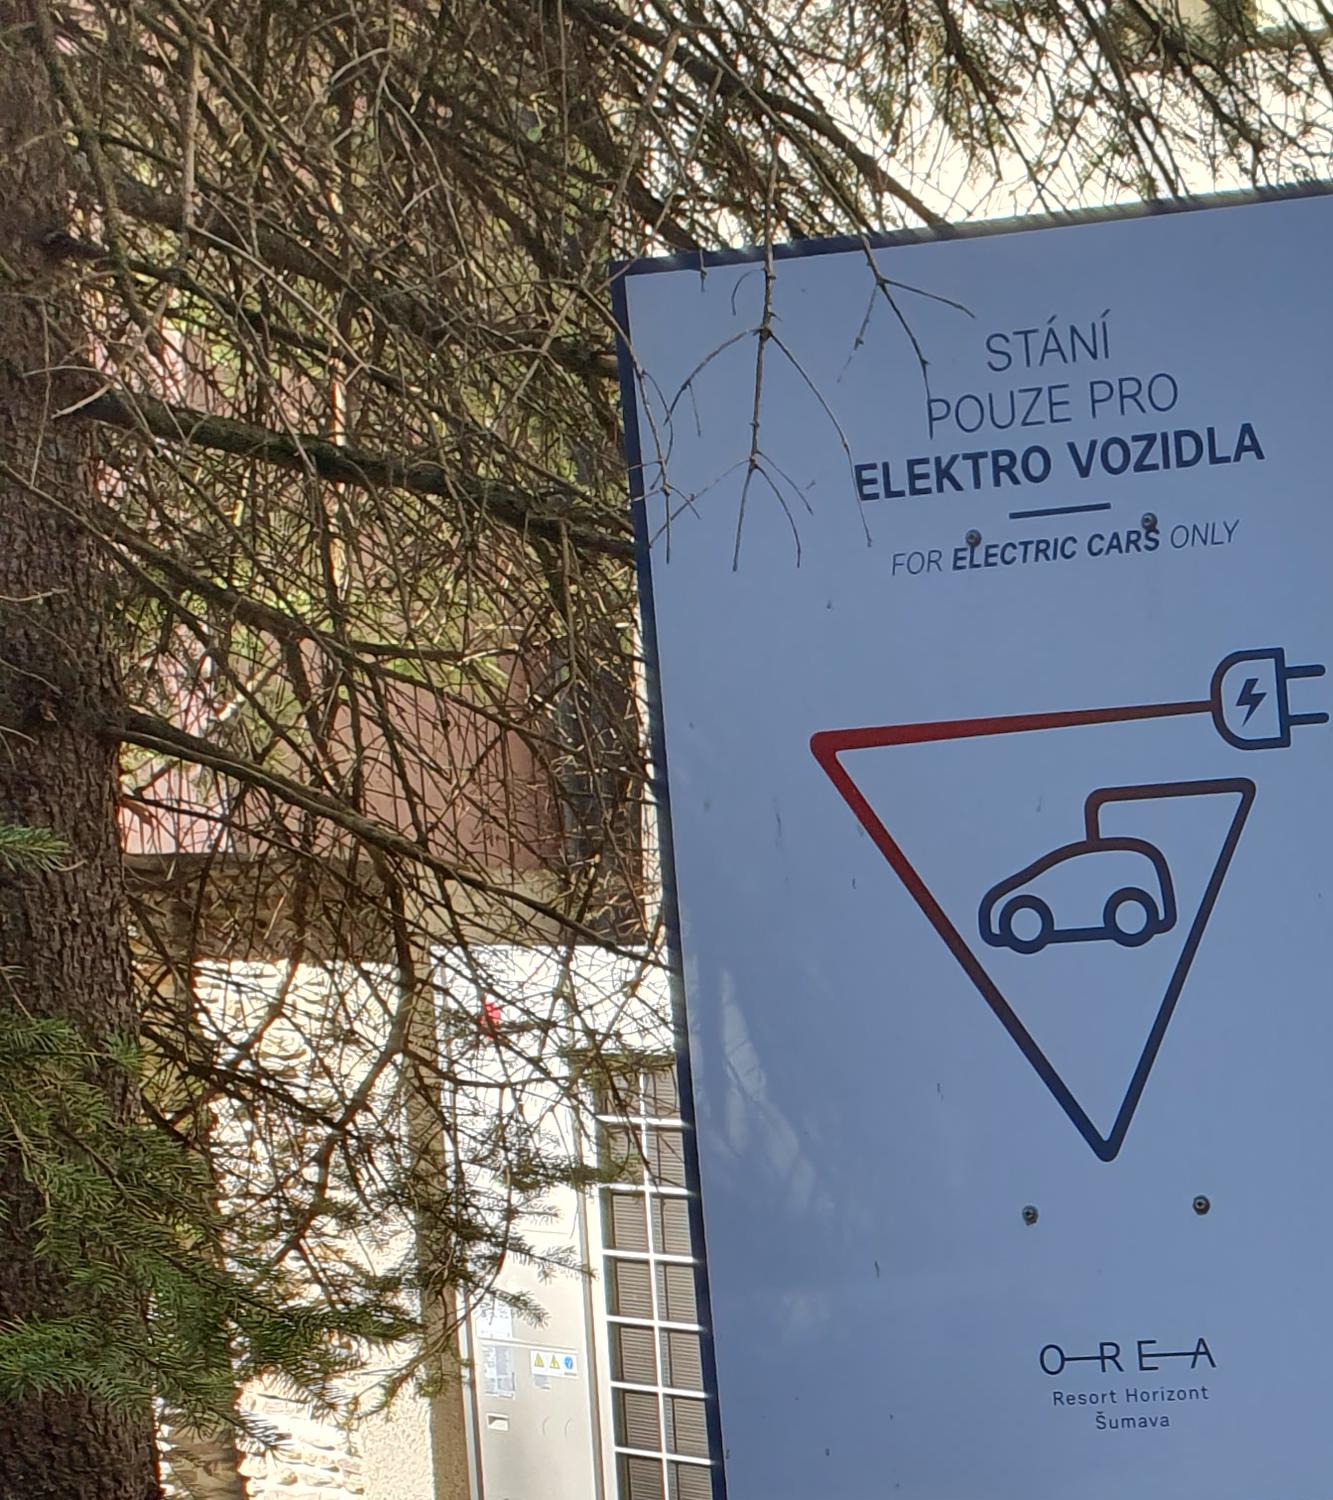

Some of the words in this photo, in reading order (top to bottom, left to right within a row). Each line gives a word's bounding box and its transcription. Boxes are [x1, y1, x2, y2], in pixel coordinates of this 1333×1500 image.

[985, 309, 1111, 372] STÁNÍ
[928, 383, 1072, 440] POUZE
[1089, 373, 1179, 419] PRO
[855, 444, 1052, 502] ELEKTRO
[1067, 422, 1266, 479] VOZIDLA
[891, 549, 943, 577] FOR
[952, 536, 1078, 571] ELECTRIC
[1086, 528, 1161, 557] CARS
[1169, 519, 1240, 550] ONLY
[1053, 1389, 1117, 1406] Resort
[1125, 1385, 1209, 1403] Horizont
[1095, 1411, 1170, 1430] Šumava
